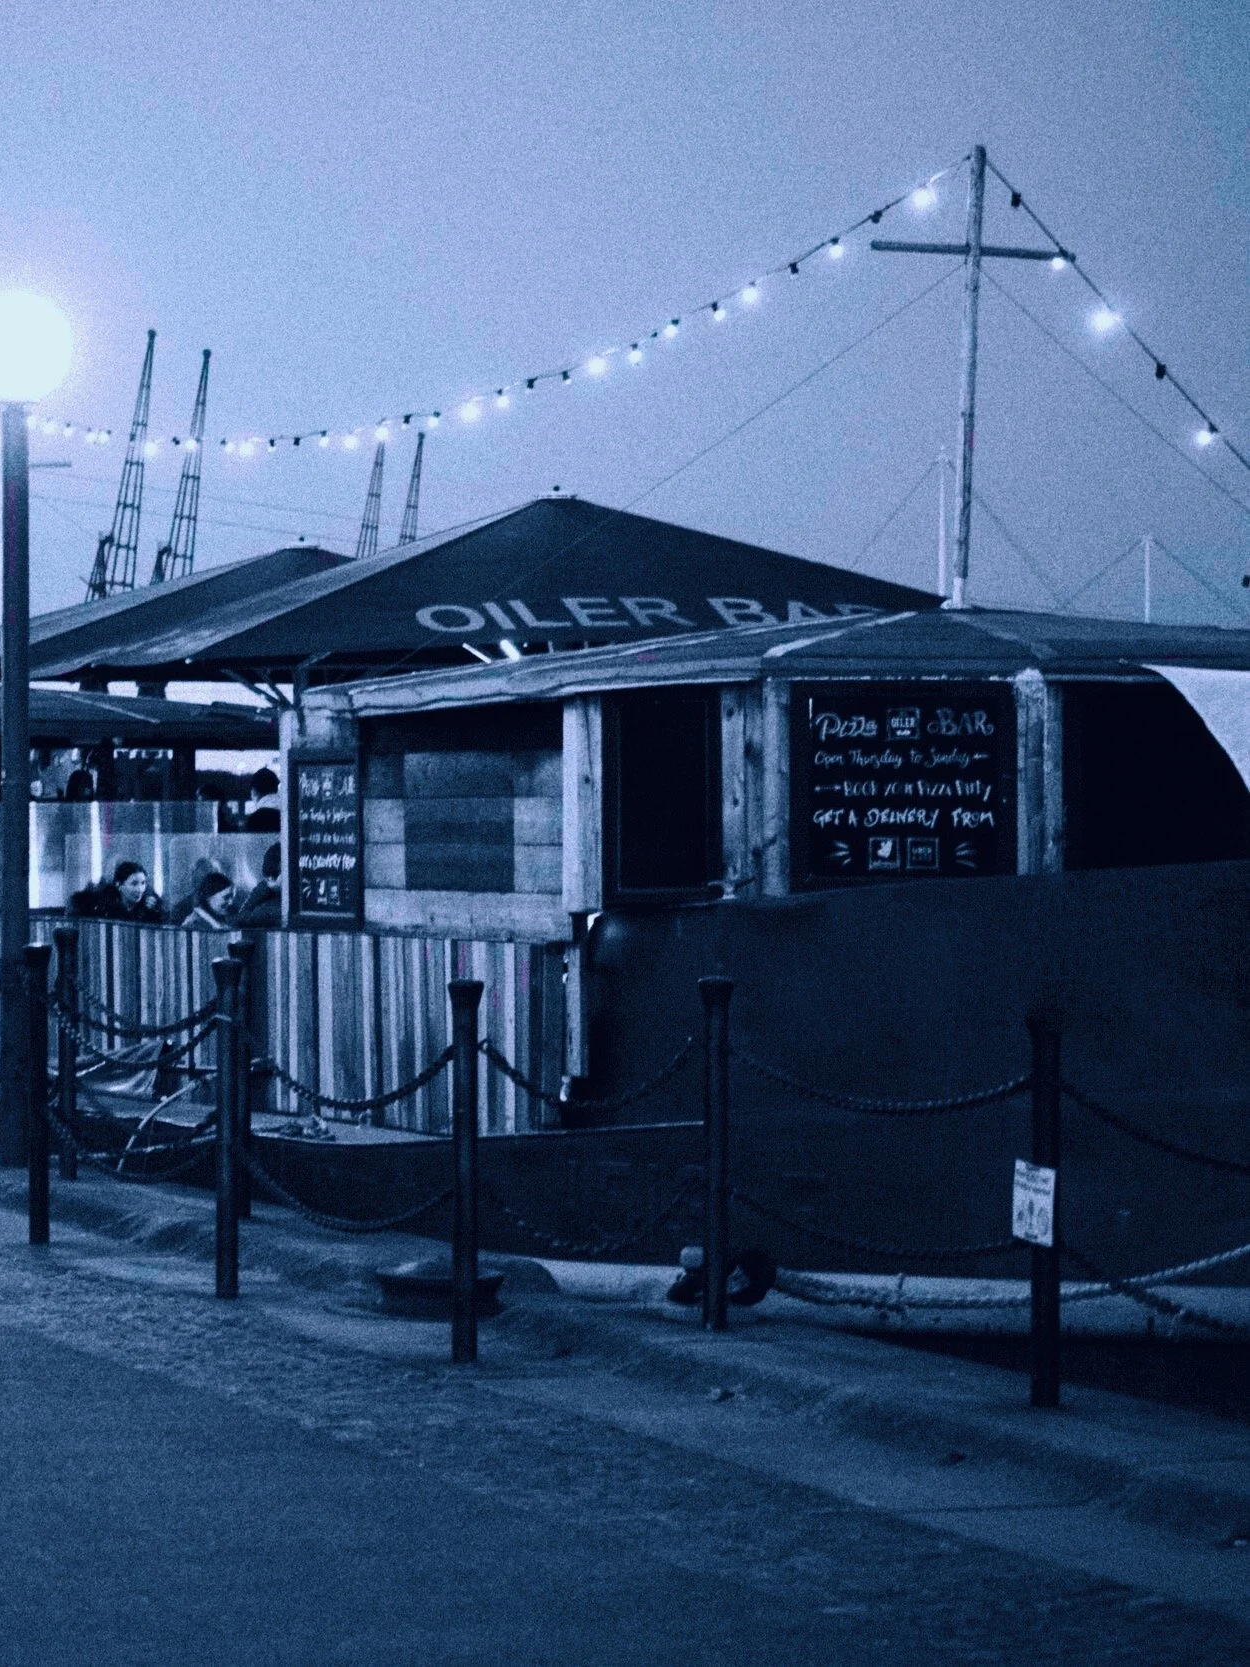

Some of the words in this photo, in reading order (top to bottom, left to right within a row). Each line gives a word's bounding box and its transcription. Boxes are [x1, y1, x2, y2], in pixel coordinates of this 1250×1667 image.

[415, 597, 698, 632] OILER
[909, 747, 924, 765] to
[813, 808, 845, 829] GET
[848, 809, 858, 828] A
[863, 807, 940, 829] DELIVERY
[951, 807, 995, 829] FROM
